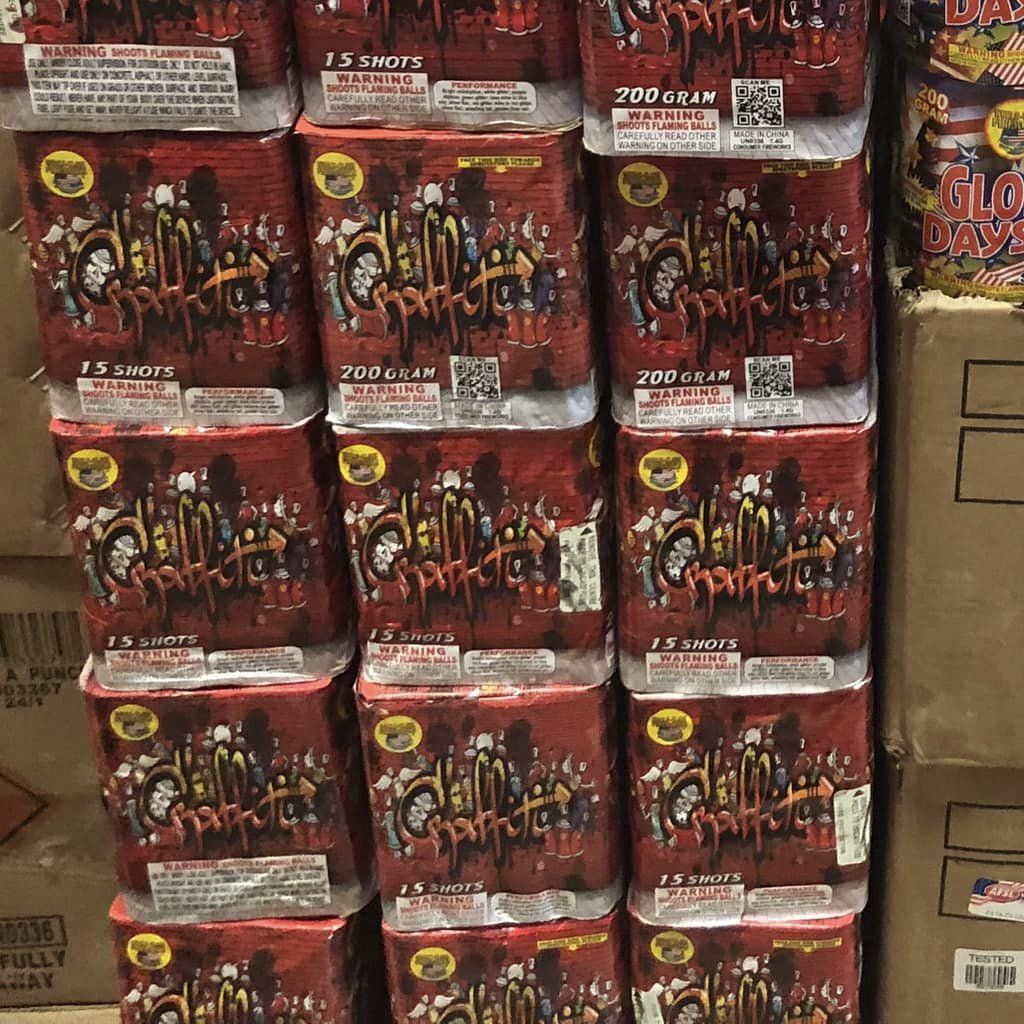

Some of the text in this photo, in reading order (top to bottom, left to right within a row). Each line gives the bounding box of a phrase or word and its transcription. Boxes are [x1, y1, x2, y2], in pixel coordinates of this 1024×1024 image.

[40, 46, 222, 60] WARNING SHOOTS FLAMING BALLS
[324, 51, 424, 70] 15 SHOTS
[336, 73, 414, 85] WARNING
[451, 82, 518, 90] PERFORMANCE
[614, 87, 717, 106] 200 GRAM
[917, 82, 950, 110] 200
[628, 110, 705, 122] WARNING
[914, 98, 950, 125] GRAM
[616, 121, 717, 131] SHOOTS FLAMING BALLS
[617, 131, 717, 141] CAREFULLY READ OTHER
[618, 141, 717, 151] WARNING ON OTHER SIDE
[79, 360, 176, 378] 15 SHOTS
[340, 365, 436, 381] 200 GRAM
[636, 369, 732, 385] 200 GRAM
[91, 380, 167, 392] WARNING
[351, 384, 426, 395] WARNING
[648, 386, 721, 398] WARNING
[107, 634, 134, 647] 15
[651, 637, 739, 650] 15 SHOTS
[659, 653, 729, 663] WARNING
[658, 872, 743, 886] 15 SHOTS
[968, 953, 1016, 965] TESTED
